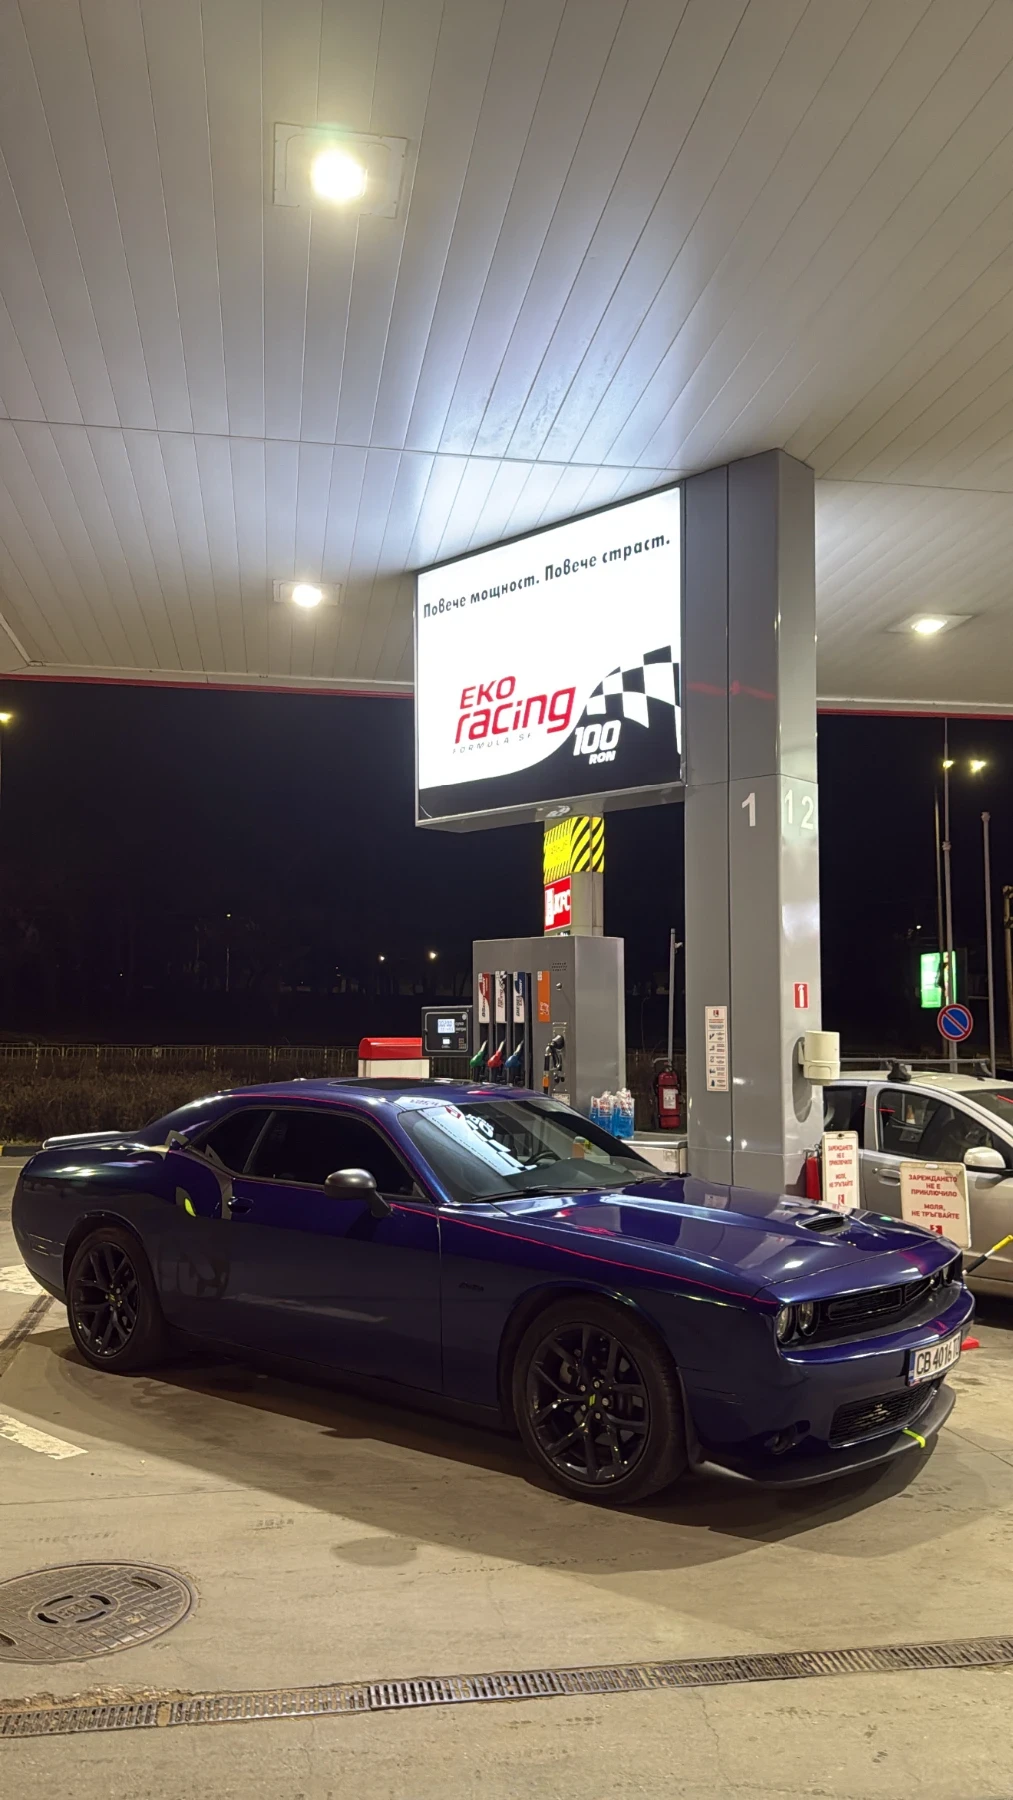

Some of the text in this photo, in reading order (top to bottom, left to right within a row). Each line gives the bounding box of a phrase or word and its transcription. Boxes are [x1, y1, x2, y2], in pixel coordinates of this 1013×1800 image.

[423, 534, 671, 618] Повече мощност. Повече страст.
[459, 675, 516, 710] EKO
[454, 686, 576, 744] racing
[573, 719, 622, 757] 100
[588, 749, 617, 765] RON
[741, 792, 756, 827] 1
[908, 1174, 958, 1183] ЗАРЕЖДАНЕТО
[911, 1188, 958, 1197] ПРИКЛЮЧИЛО
[921, 1211, 960, 1220] ТРЪГВАЙТЕ
[916, 1351, 931, 1375] CB
